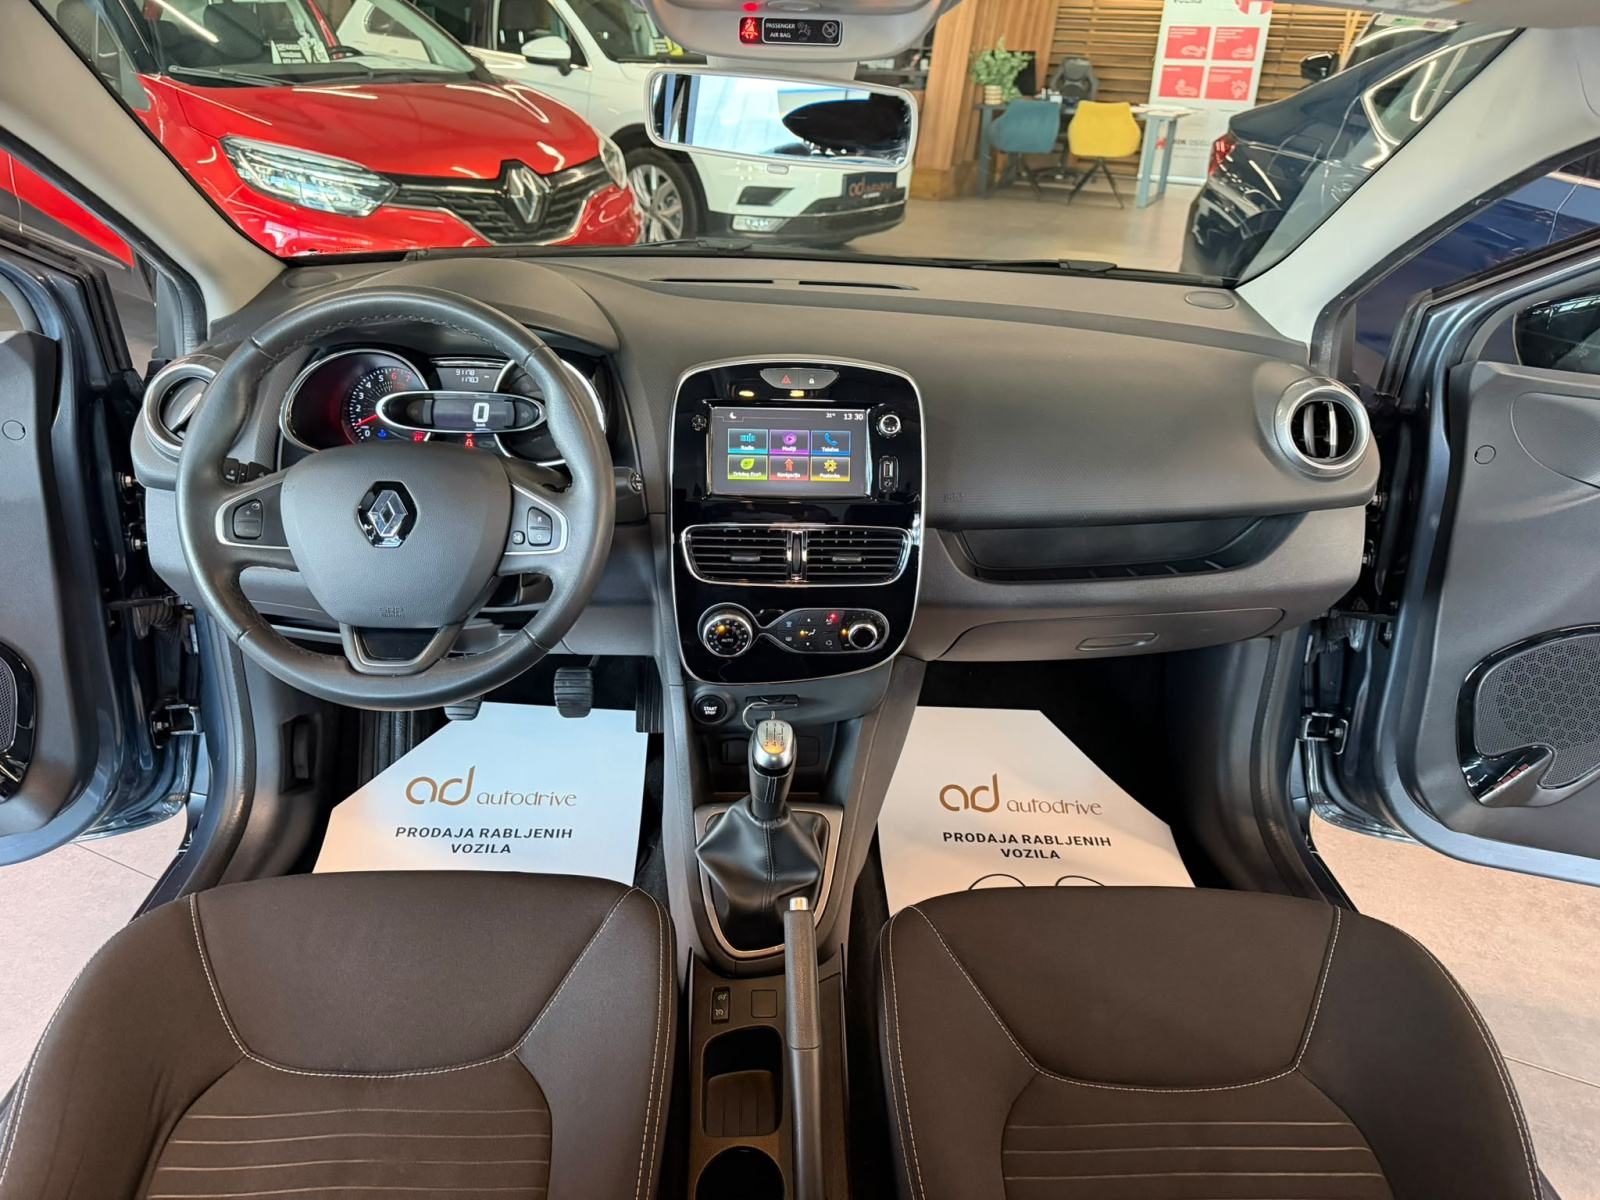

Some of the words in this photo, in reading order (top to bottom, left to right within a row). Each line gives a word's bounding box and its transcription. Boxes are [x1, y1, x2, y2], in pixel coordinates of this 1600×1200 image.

[378, 374, 384, 382] 5
[391, 372, 398, 380] 6
[358, 392, 364, 400] 3
[472, 402, 490, 423] 0
[406, 766, 475, 806] ad
[476, 790, 577, 807] autodrive
[939, 773, 1000, 813] ad
[1006, 798, 1103, 816] autodrive
[395, 826, 475, 839] PRODAJA
[479, 827, 573, 839] RABLJENIH
[942, 831, 1019, 845] PRODAJA
[1022, 834, 1112, 847] RABLJENIH
[450, 843, 512, 854] VOZILA
[999, 848, 1061, 860] VOZILA
